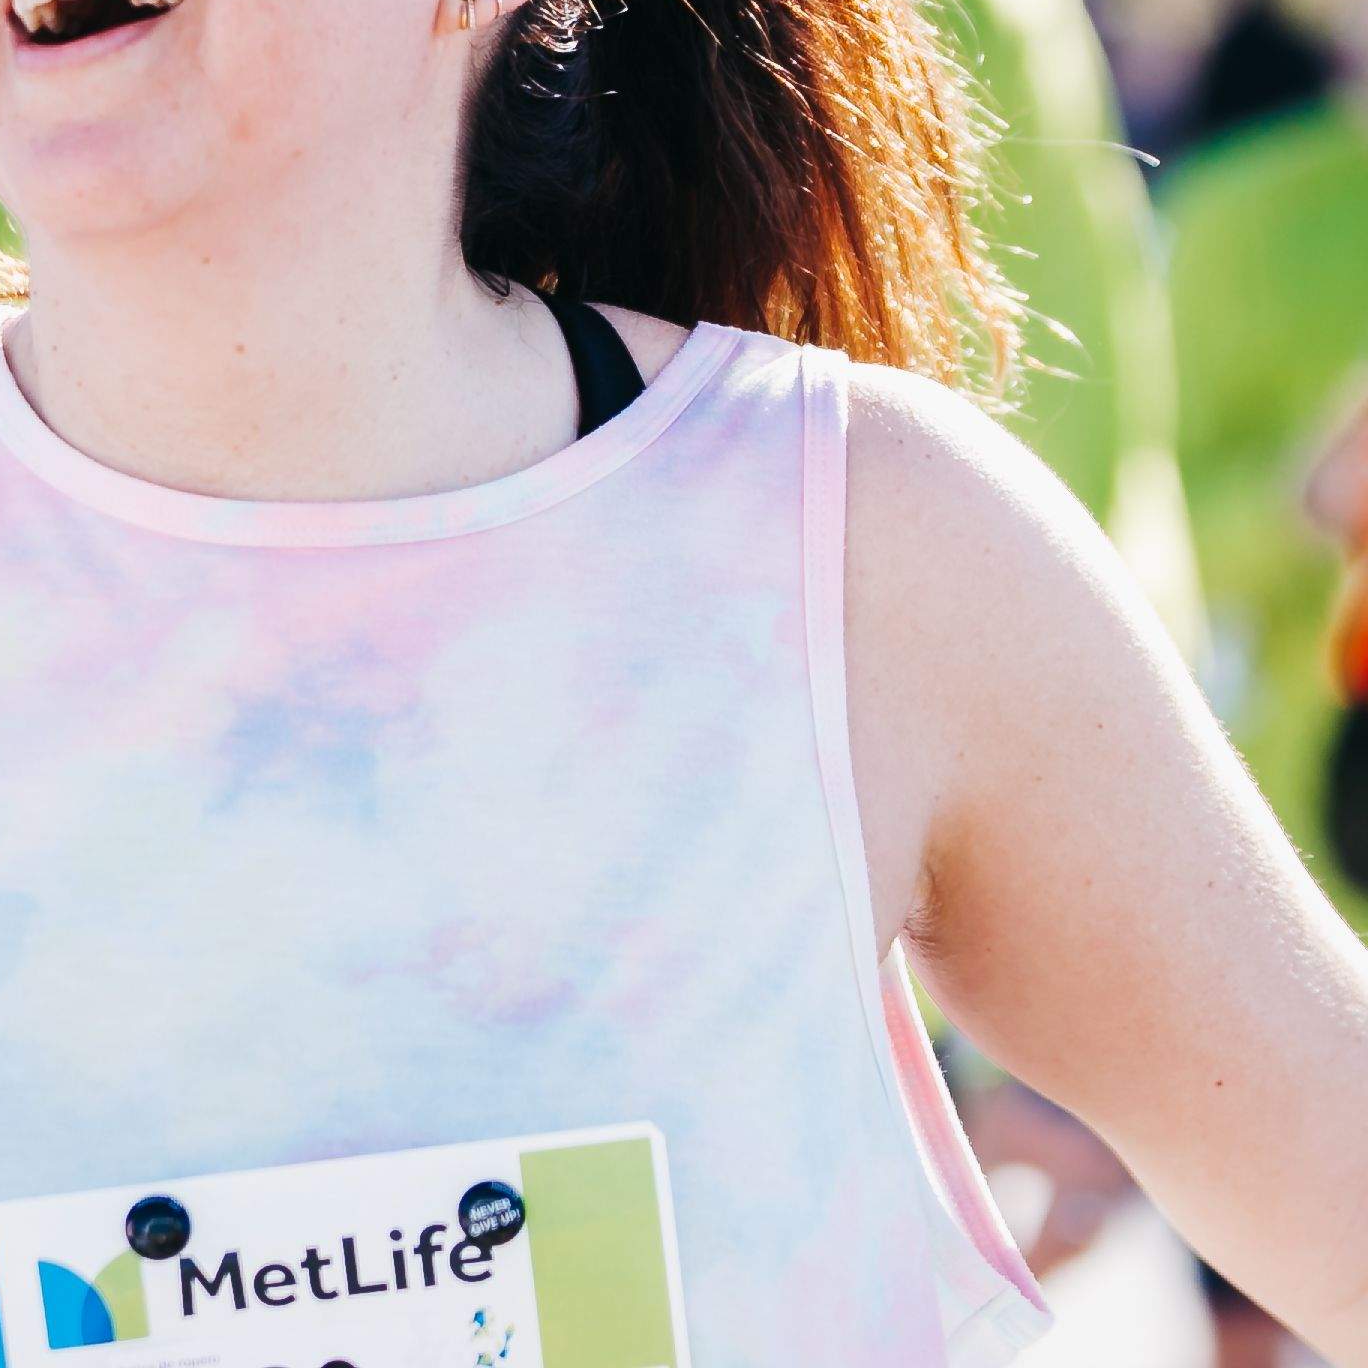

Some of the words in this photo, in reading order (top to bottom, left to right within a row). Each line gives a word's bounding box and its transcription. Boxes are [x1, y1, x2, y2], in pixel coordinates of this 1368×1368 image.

[469, 1198, 512, 1222] NEVER
[469, 1216, 499, 1237] GIVE
[179, 1223, 494, 1317] MetLife
